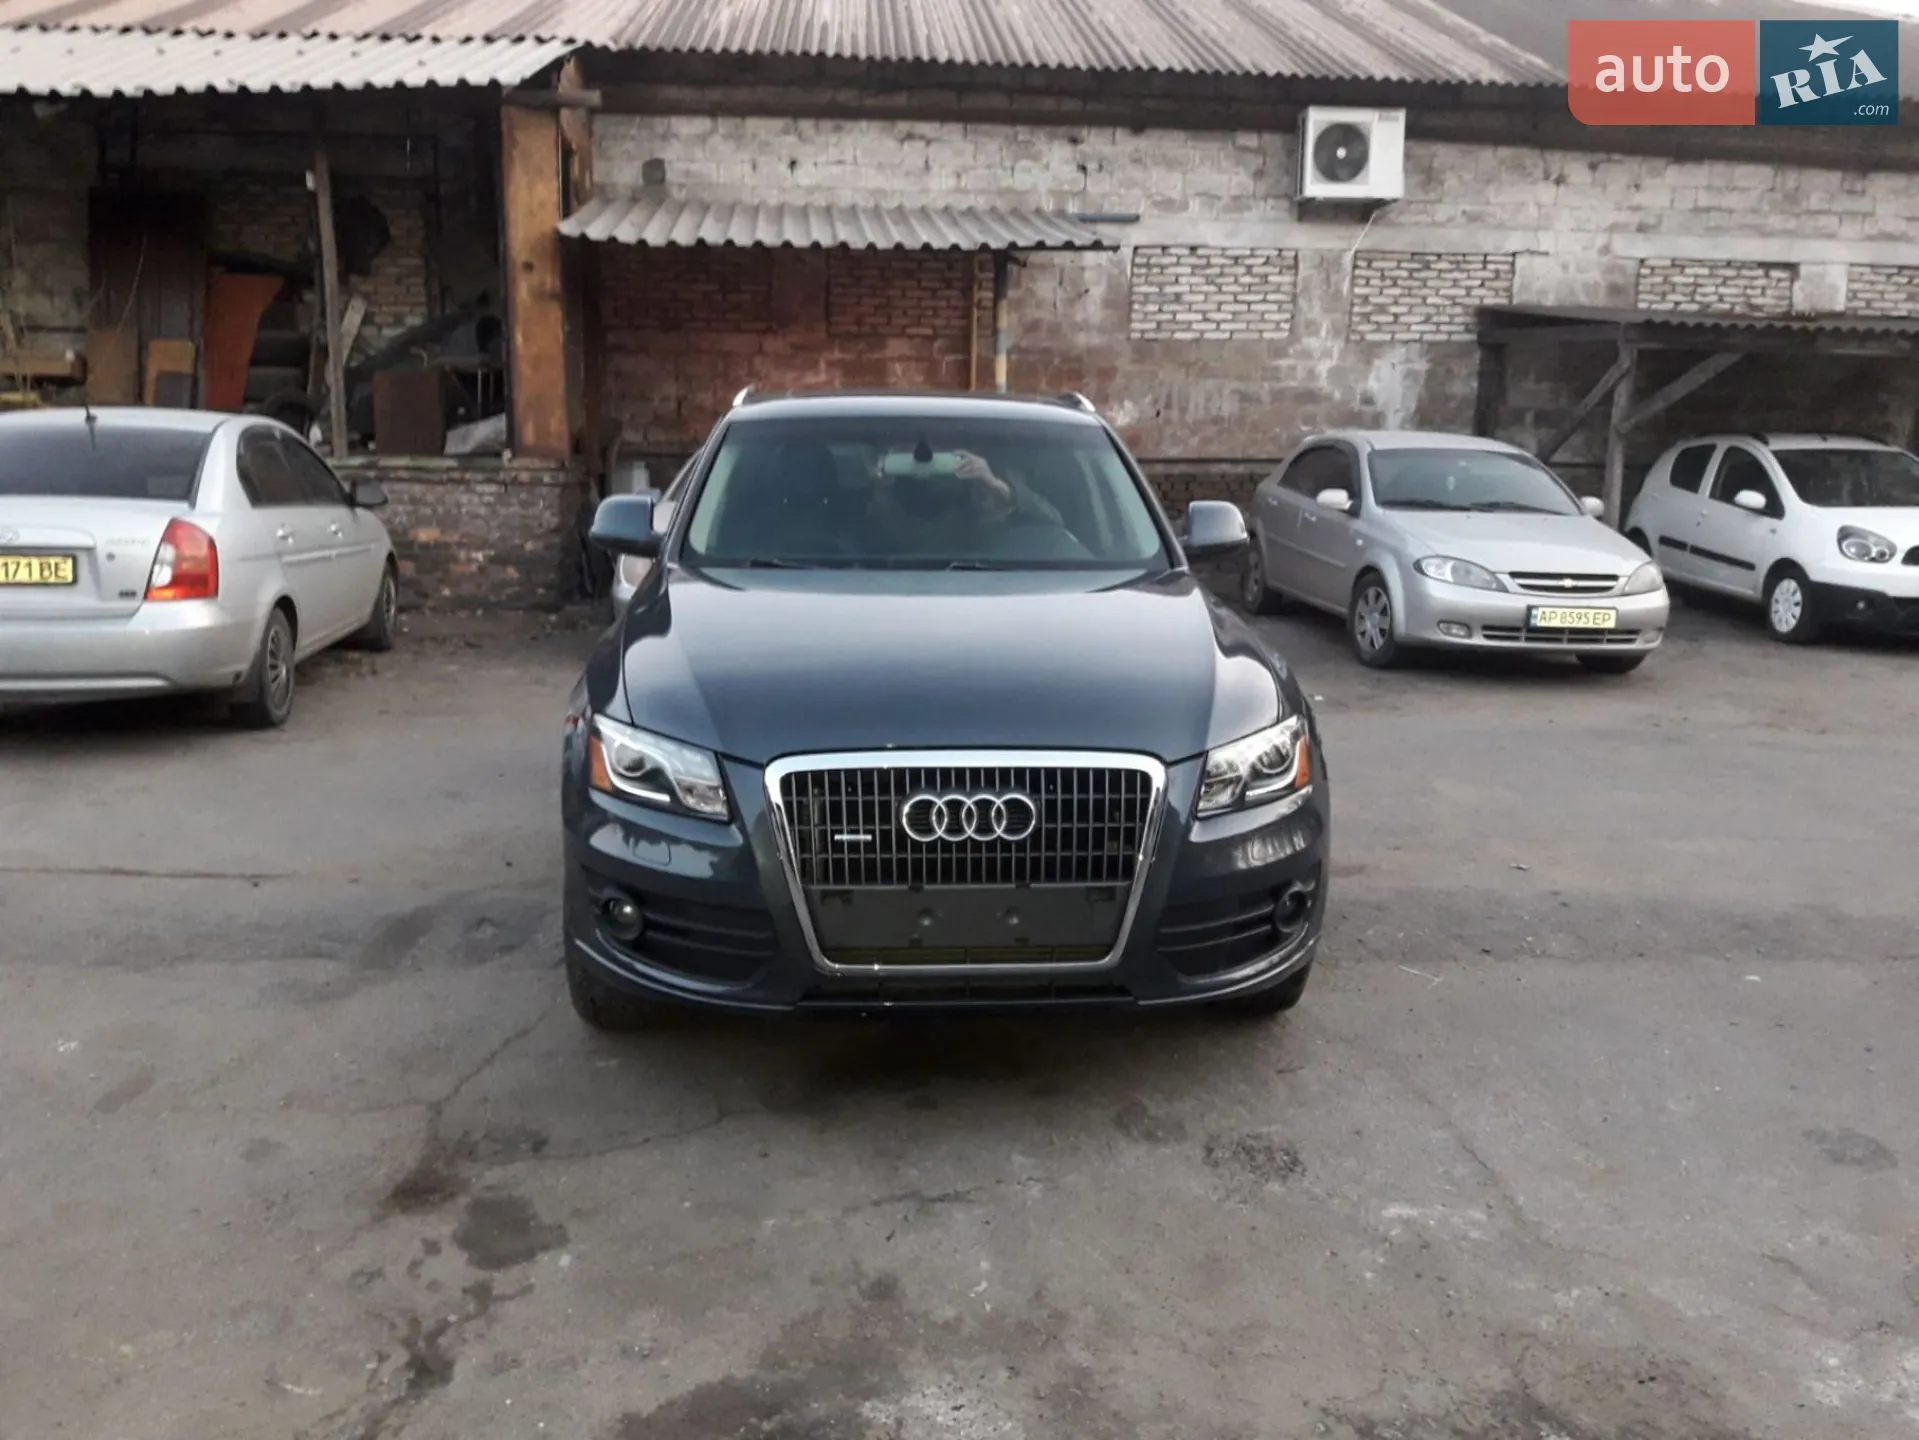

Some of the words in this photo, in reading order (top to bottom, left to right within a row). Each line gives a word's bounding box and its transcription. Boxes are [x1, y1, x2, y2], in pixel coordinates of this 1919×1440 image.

[39, 560, 68, 580] BE
[1539, 610, 1558, 625] AP
[1560, 611, 1590, 625] 8595
[1592, 612, 1611, 626] EP
